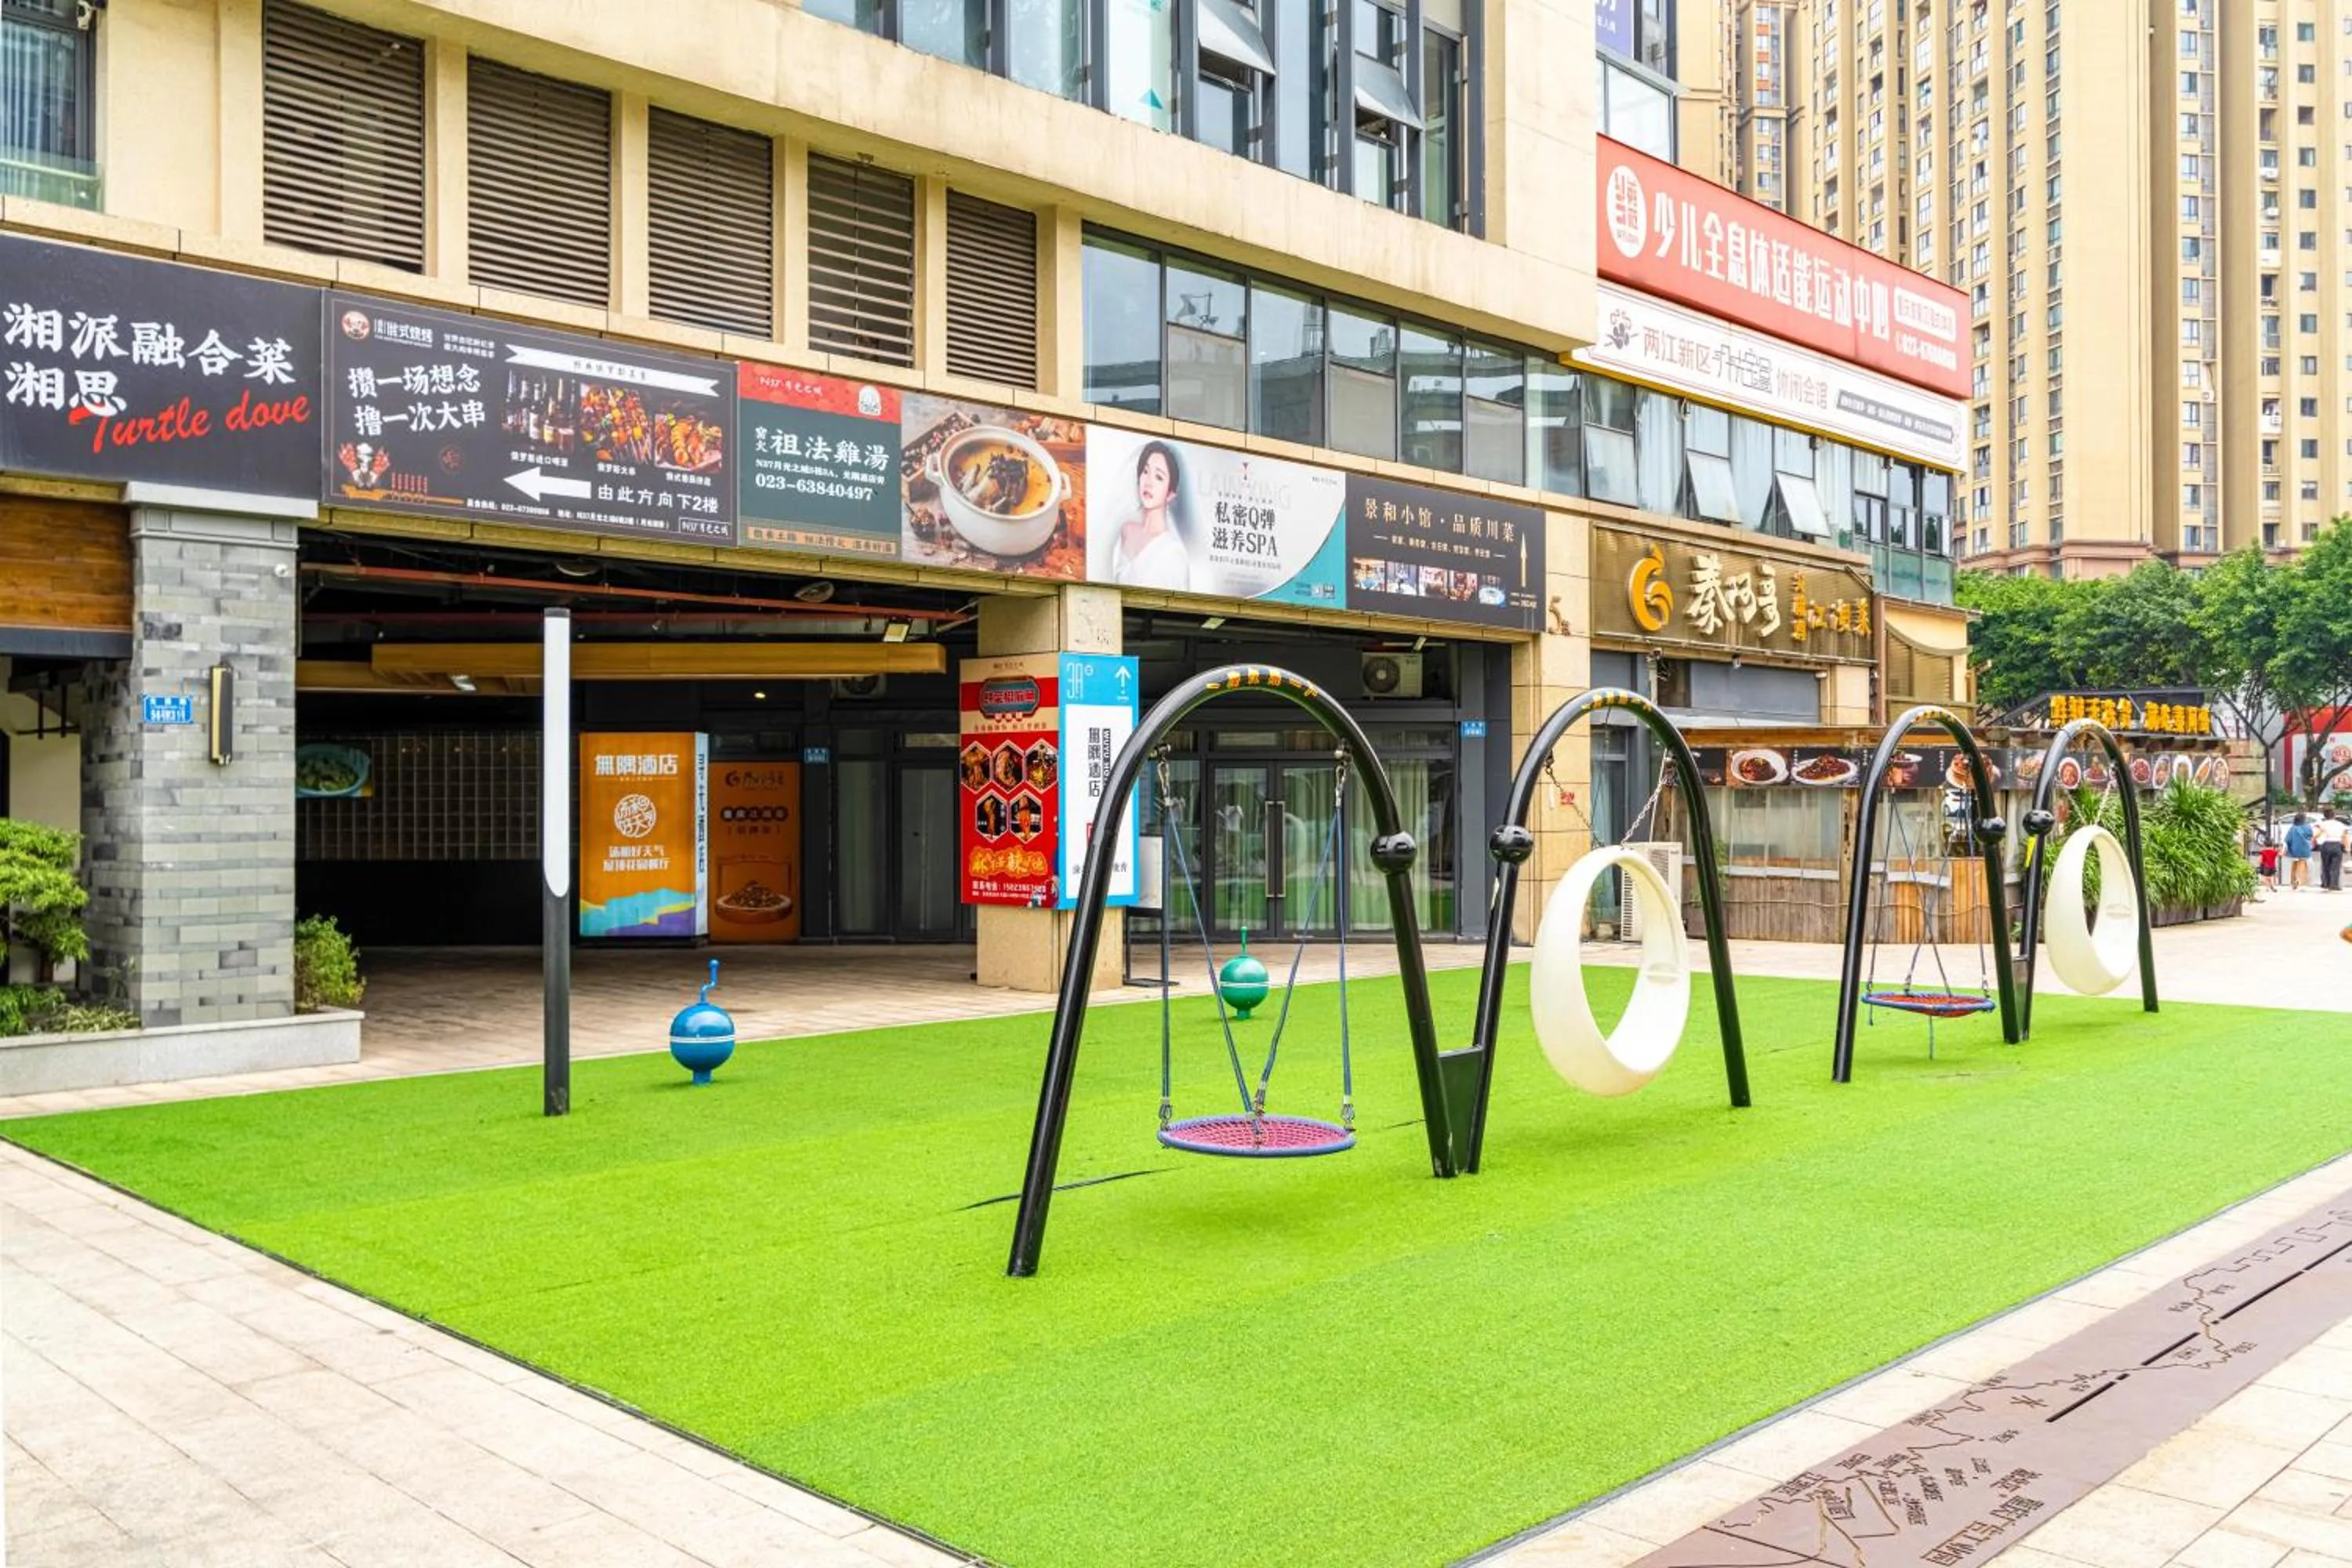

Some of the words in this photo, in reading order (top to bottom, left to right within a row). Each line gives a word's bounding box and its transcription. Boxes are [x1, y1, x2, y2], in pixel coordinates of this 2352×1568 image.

[2, 303, 297, 385] 湘派融合菜
[4, 361, 128, 418] 湘思
[68, 396, 213, 453] Turtle
[226, 389, 312, 432] dove
[354, 400, 486, 437] 撸一次大串
[770, 428, 891, 471] 祖法雞湯
[597, 483, 719, 514] 由此方向下2楼
[754, 472, 874, 502] 023-63840497
[1215, 500, 1276, 532] 私密Q弹
[1212, 526, 1279, 557] 滋养SPA
